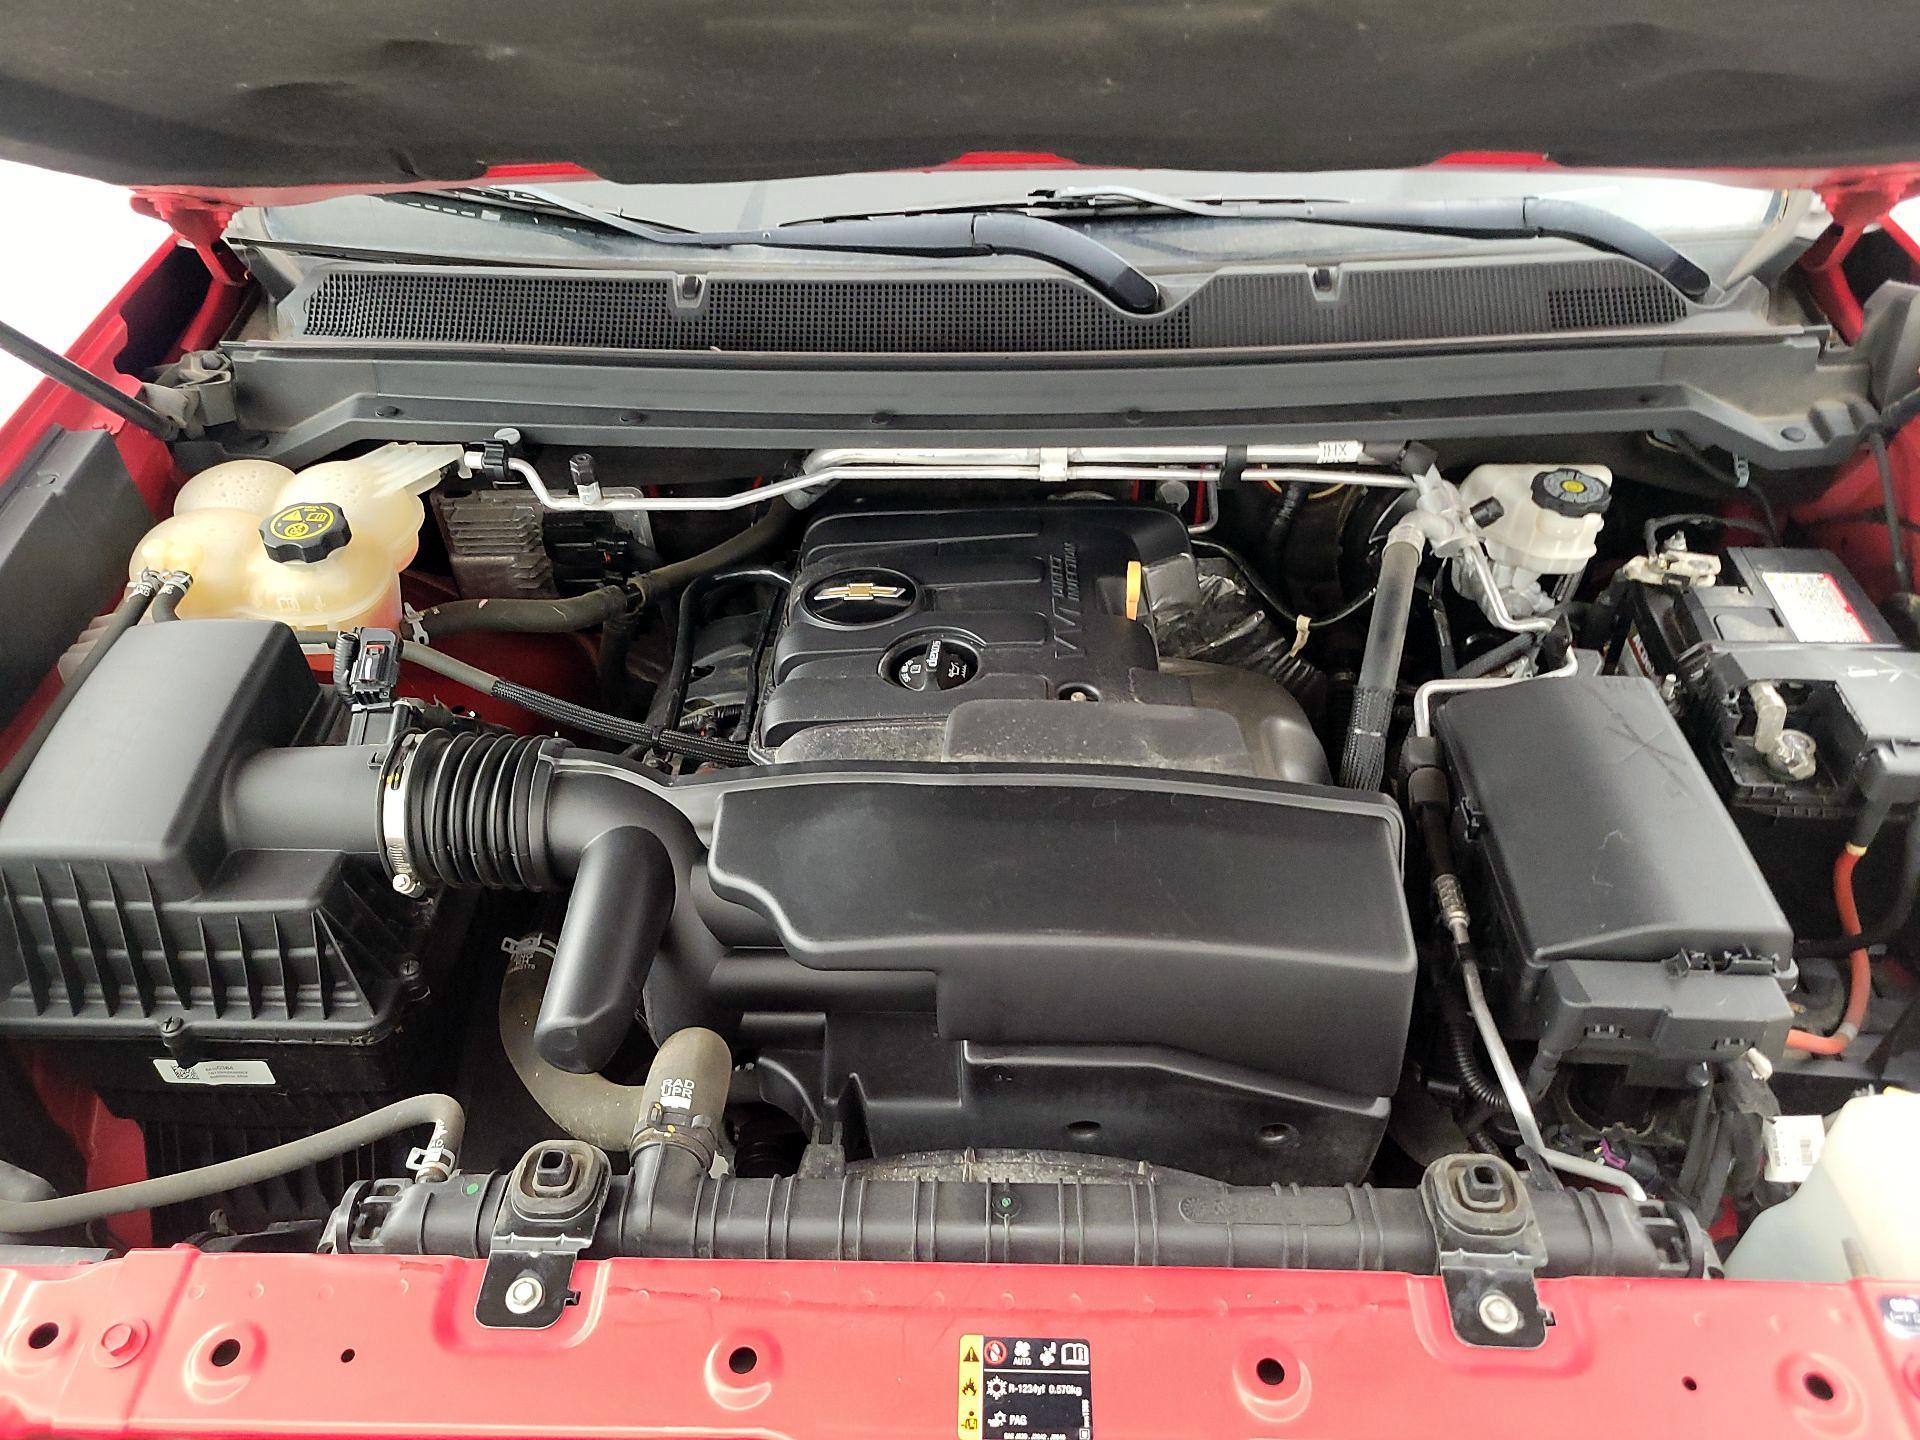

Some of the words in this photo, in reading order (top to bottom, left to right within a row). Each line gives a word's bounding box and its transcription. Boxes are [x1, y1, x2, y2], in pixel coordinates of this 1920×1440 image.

[1050, 555, 1064, 598] DIRECT
[926, 640, 942, 667] dexos
[661, 1078, 695, 1089] RAD
[661, 1086, 693, 1099] UPR
[1012, 1357, 1032, 1366] AUTO
[1008, 1384, 1046, 1396] R-1234yf
[1048, 1384, 1083, 1397] 0.570kg
[1009, 1414, 1028, 1426] PAG
